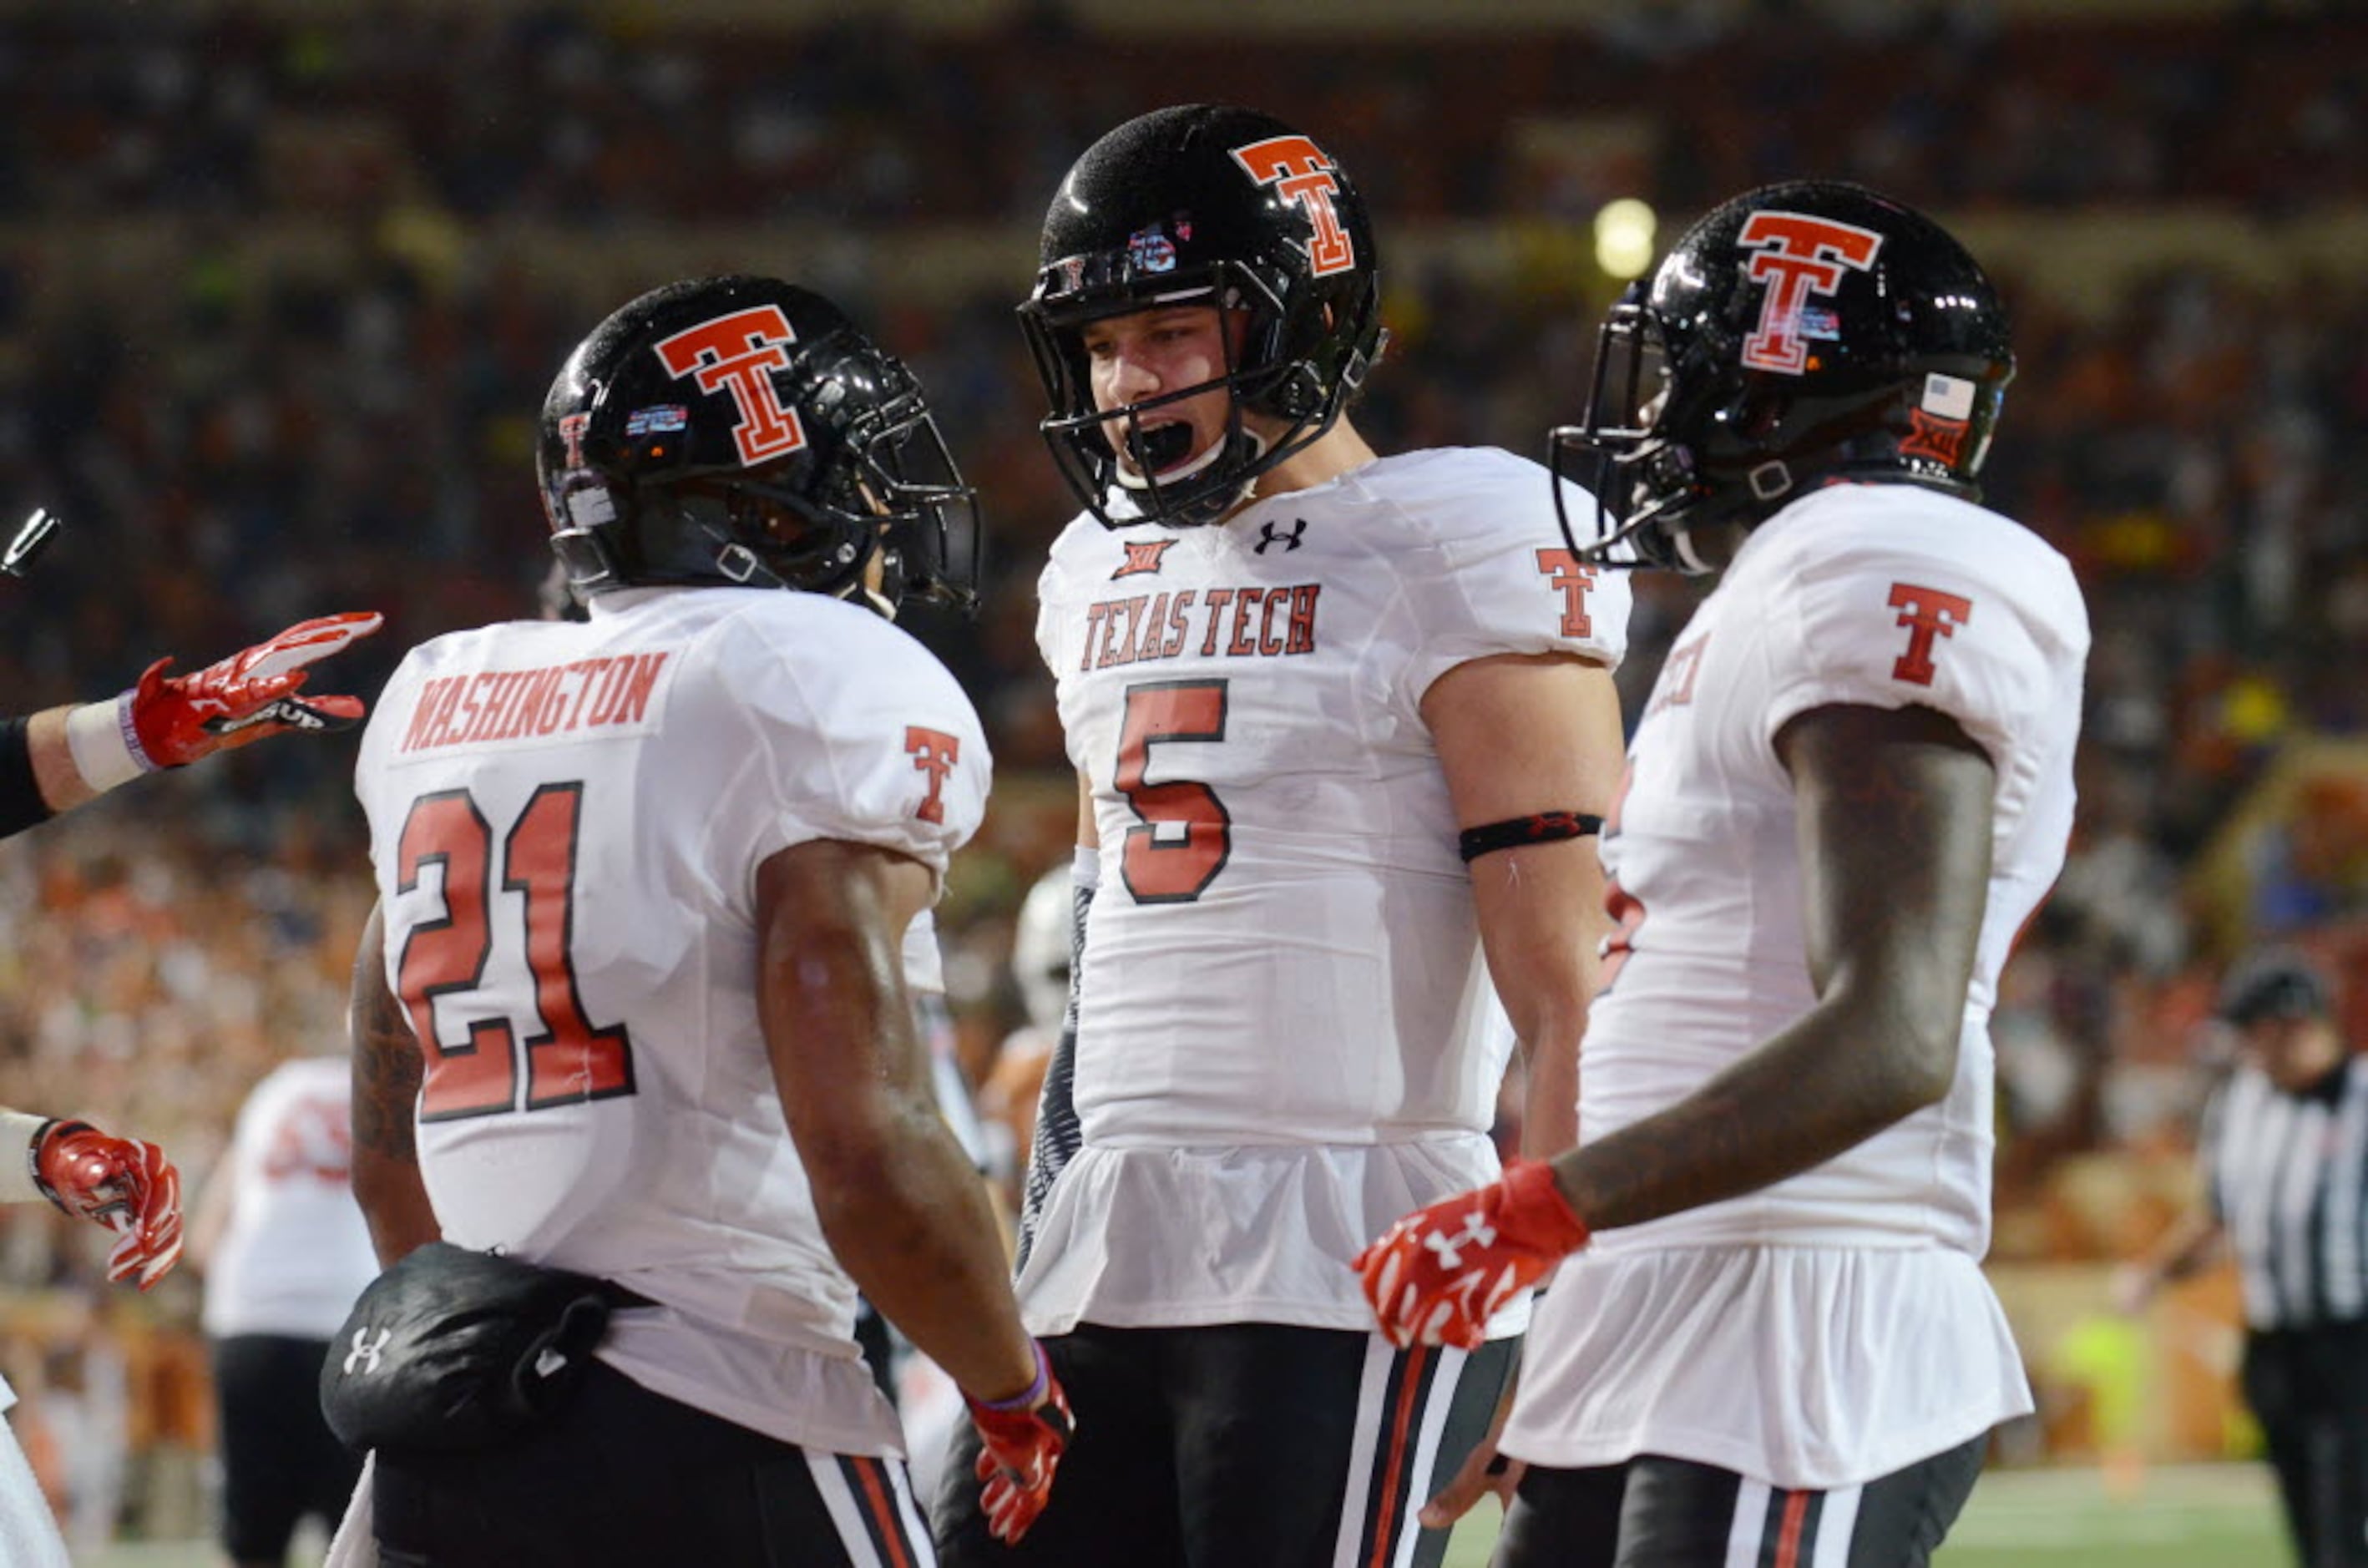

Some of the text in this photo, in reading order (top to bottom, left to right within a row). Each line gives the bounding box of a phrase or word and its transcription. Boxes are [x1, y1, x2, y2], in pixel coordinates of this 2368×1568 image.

[401, 651, 669, 753] WASHINGTON
[1080, 582, 1321, 670] TEXAS TECH
[1113, 678, 1231, 905] 5
[397, 779, 639, 1124] 21
